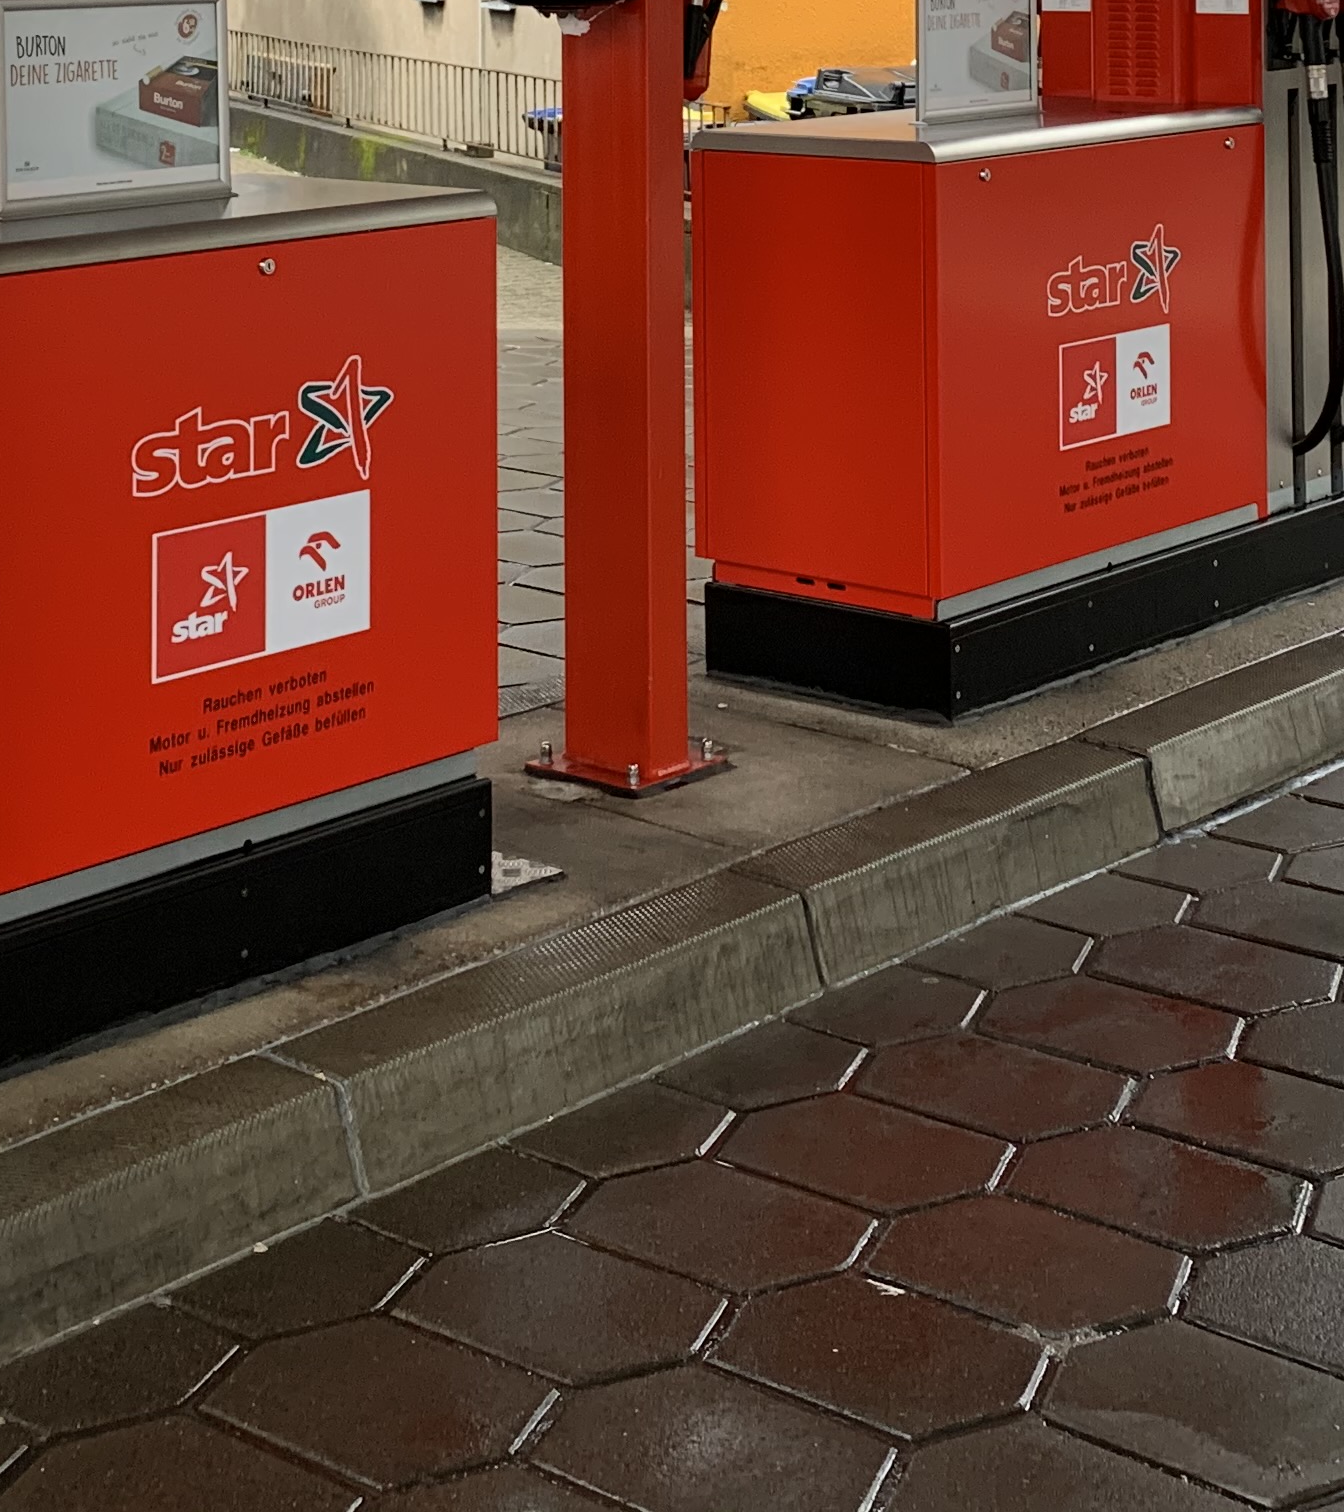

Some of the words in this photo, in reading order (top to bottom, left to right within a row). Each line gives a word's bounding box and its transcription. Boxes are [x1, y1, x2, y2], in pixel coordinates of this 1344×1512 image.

[927, 14, 947, 31] DEINE
[950, 13, 981, 29] ZIGARETTE
[16, 34, 66, 59] BURTON
[10, 63, 50, 87] DEINE
[55, 58, 119, 83] ZIGARETTE
[153, 92, 184, 109] Burton
[1047, 255, 1127, 317] star
[1130, 383, 1157, 400] ORLEN
[1069, 402, 1098, 423] star
[131, 406, 289, 498] star
[1085, 456, 1116, 471] Rauchen
[1119, 447, 1149, 462] verboten
[1059, 484, 1080, 497] Motor
[1064, 502, 1076, 513] Nur
[292, 574, 346, 602] ORLEN
[314, 593, 346, 609] GROUP
[170, 610, 228, 643] star
[202, 685, 262, 713] Rauchen
[269, 668, 326, 698] verboten
[149, 730, 191, 754] Motor
[198, 724, 210, 739] u.
[217, 698, 311, 735] Fremdheizung
[317, 679, 374, 712] abstellen
[158, 756, 184, 777] Nur
[191, 737, 255, 768] zulässige
[262, 722, 309, 747] Gefäße
[315, 705, 367, 734] befüllen
